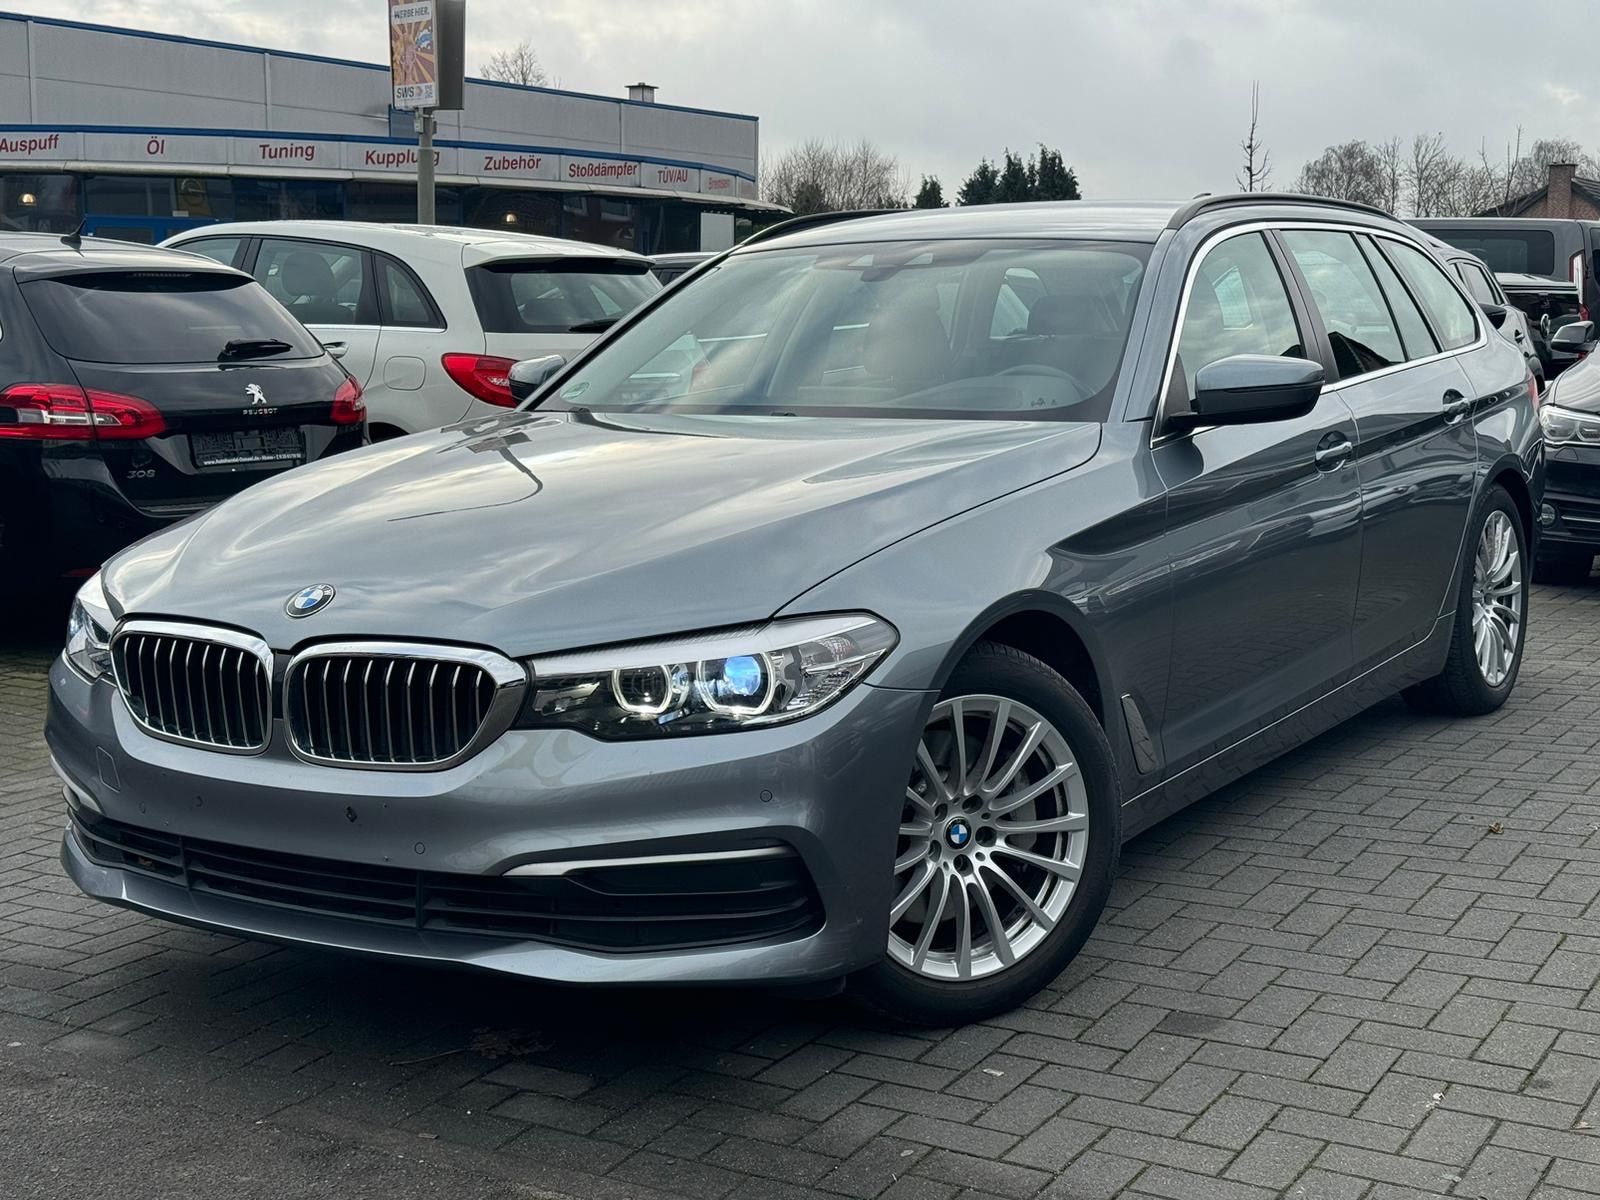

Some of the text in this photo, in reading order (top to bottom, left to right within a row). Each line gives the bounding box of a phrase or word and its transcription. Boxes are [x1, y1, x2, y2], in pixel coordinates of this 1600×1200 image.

[396, 86, 414, 98] SWS
[0, 134, 59, 155] Auspuff
[147, 135, 165, 155] Öl
[259, 142, 315, 161] Tuning
[365, 149, 440, 168] Kupplug
[484, 154, 542, 171] Zubehör
[568, 162, 638, 179] Stoßdämpfer
[657, 167, 688, 183] TÜV/AU
[126, 469, 156, 479] 308
